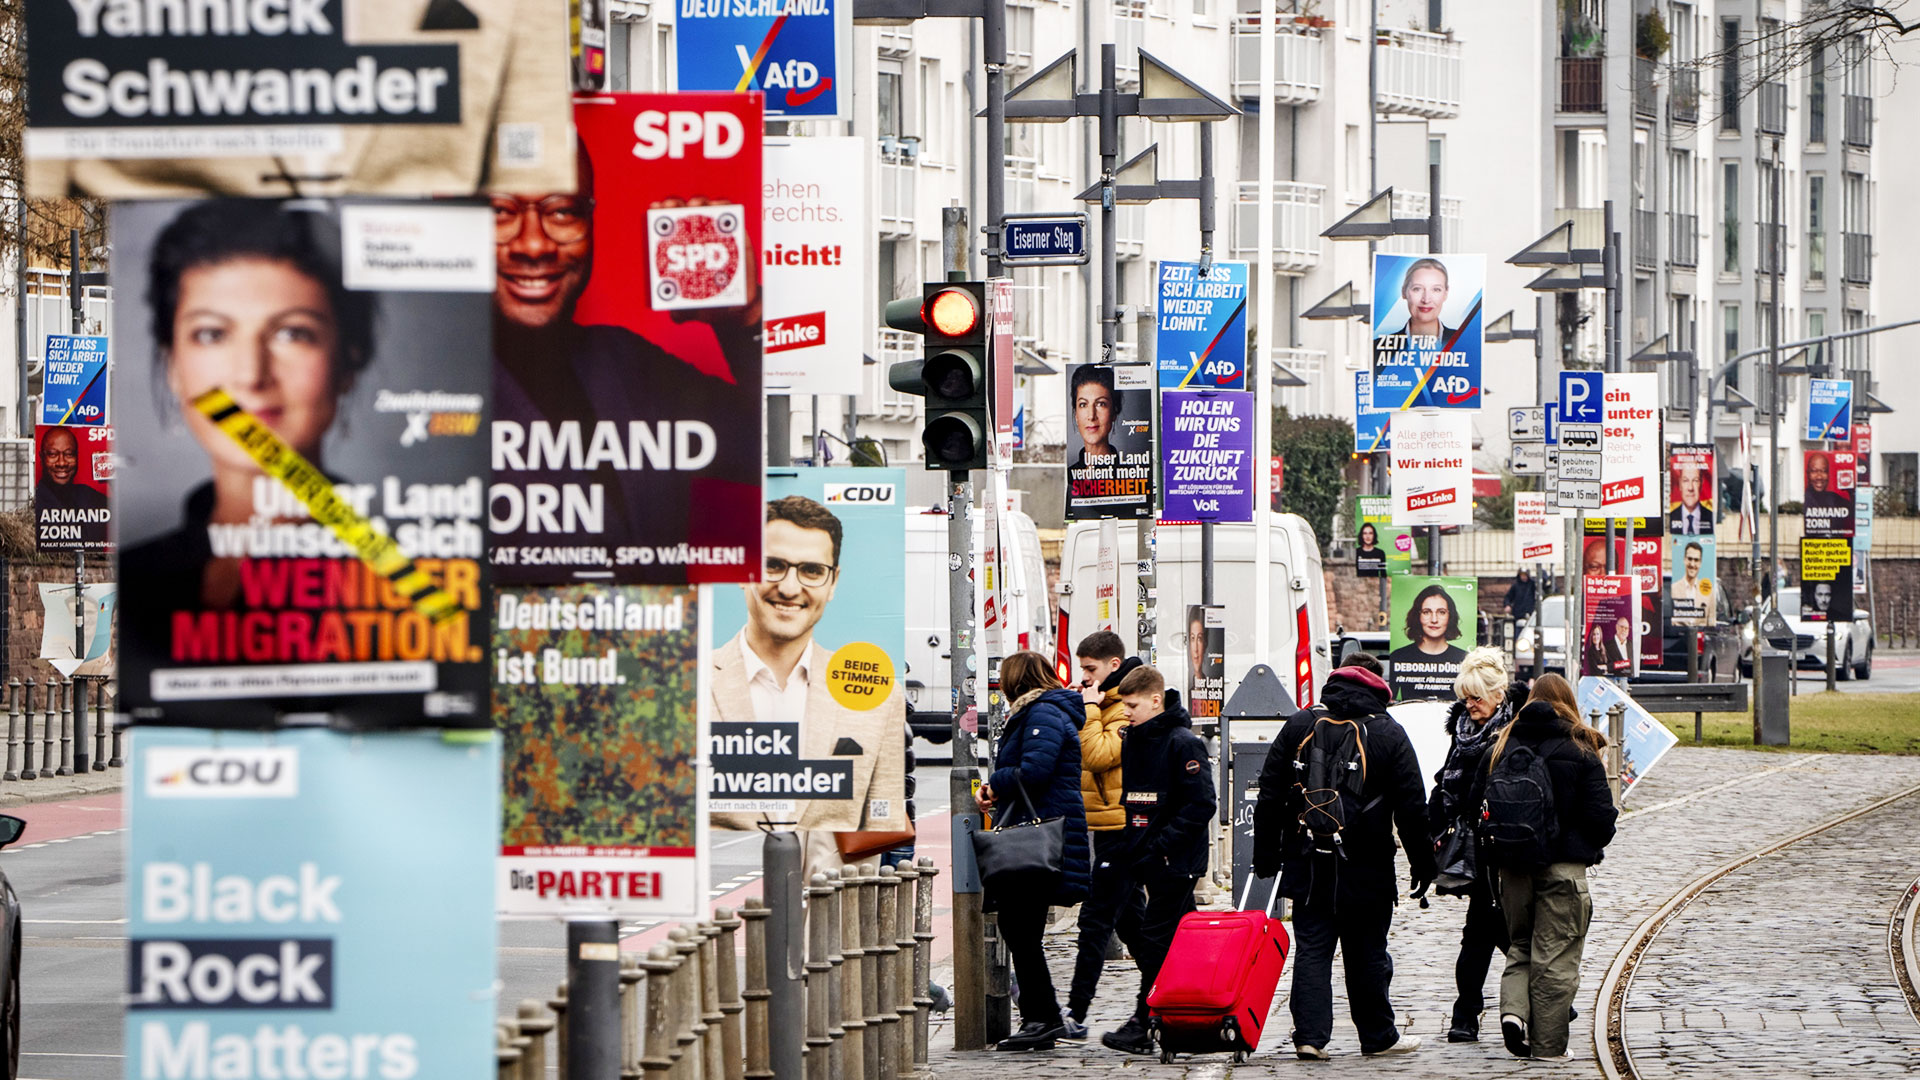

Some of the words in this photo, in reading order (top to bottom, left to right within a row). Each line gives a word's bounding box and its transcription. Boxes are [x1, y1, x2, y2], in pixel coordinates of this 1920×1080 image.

[681, 0, 829, 18] DEUTSCHLAND.
[70, 0, 334, 37] Yannick
[763, 59, 819, 89] AfD
[62, 56, 446, 117] Schwander
[632, 110, 744, 159] SPD
[763, 178, 820, 198] ehen
[764, 202, 843, 222] rechts.
[1014, 227, 1050, 249] Eiserner
[1054, 226, 1074, 253] Steg
[666, 242, 730, 273] SPD
[1162, 266, 1194, 282] ZEIT,
[1162, 282, 1192, 297] SICH
[1194, 282, 1243, 298] ARBEIT
[1163, 299, 1213, 315] WIEDER
[1161, 316, 1207, 331] LOHNT.
[49, 338, 71, 350] ZEIT,
[73, 339, 97, 350] DASS
[1377, 335, 1408, 350] ZEIT
[1410, 334, 1437, 350] FÜR
[48, 350, 70, 361] SICH
[71, 351, 105, 362] ARBEIT
[1377, 351, 1415, 366] ALICE
[1419, 351, 1469, 367] WEIDEL
[49, 361, 84, 374] WIEDER
[1204, 360, 1236, 375] AfD
[47, 373, 80, 385] LOHNT.
[1432, 375, 1470, 394] AfD
[1566, 378, 1590, 416] P
[1605, 389, 1630, 402] ein
[77, 405, 99, 416] AfD
[1180, 401, 1234, 415] HOLEN
[1608, 407, 1653, 419] unter
[1175, 417, 1205, 431] WIR
[1207, 417, 1241, 432] UNS
[88, 428, 116, 441] SPD
[1193, 433, 1220, 448] DIE
[1397, 430, 1417, 439] Alle
[1420, 430, 1453, 441] gehen
[1397, 440, 1423, 449] nach
[1427, 440, 1463, 449] rechts.
[1607, 443, 1641, 451] Reiche
[1084, 452, 1116, 465] Unser
[1119, 451, 1149, 464] Land
[1169, 450, 1245, 464] ZUKUNFT
[1398, 459, 1421, 468] Wir
[1424, 458, 1463, 468] nicht!
[1562, 458, 1597, 467] gebühren-
[1835, 454, 1854, 463] SPD
[1071, 466, 1114, 480] verdient
[1116, 465, 1149, 479] mehr
[1173, 464, 1240, 481] ZURÜCK
[1566, 467, 1593, 476] pflichtig
[844, 487, 891, 501] CDU
[1071, 479, 1150, 496] SICHERHEIT.
[1560, 491, 1573, 499] max
[1577, 490, 1584, 499] 15
[1586, 490, 1598, 500] min
[1606, 484, 1640, 501] Linke
[384, 475, 483, 519] Land
[1410, 498, 1426, 508] Die
[1427, 493, 1453, 506] Linke
[490, 483, 604, 534] ORN
[1193, 499, 1219, 511] Volt
[40, 509, 111, 523] ARMAND
[1806, 508, 1849, 518] ARMAND
[1806, 519, 1831, 528] ZORN
[40, 526, 81, 539] ZORN
[397, 518, 483, 559] sich
[489, 547, 516, 564] AT
[521, 547, 613, 568] SCANNEN,
[616, 547, 654, 564] SPD
[656, 543, 745, 565] WÄHLEN!
[499, 594, 683, 631] Deutschland
[171, 608, 483, 663] MIGRATION.
[499, 648, 536, 684] ist
[543, 648, 626, 685] Bund.
[844, 660, 879, 673] BEIDE
[1394, 663, 1437, 673] DEBORAH
[831, 670, 889, 686] STIMMEN
[1207, 677, 1223, 688] Land
[843, 684, 875, 696] CDU
[1208, 688, 1222, 699] sich
[709, 728, 792, 755] nnick
[189, 759, 283, 786] CDU
[708, 767, 846, 793] hwander
[708, 801, 732, 810] kfurt
[734, 801, 757, 810] nach
[759, 801, 788, 810] Berlin
[511, 870, 534, 890] Die
[538, 871, 663, 899] PARTEI
[143, 862, 342, 923] Black
[143, 941, 326, 1003] Rock
[143, 1022, 419, 1080] Matters
